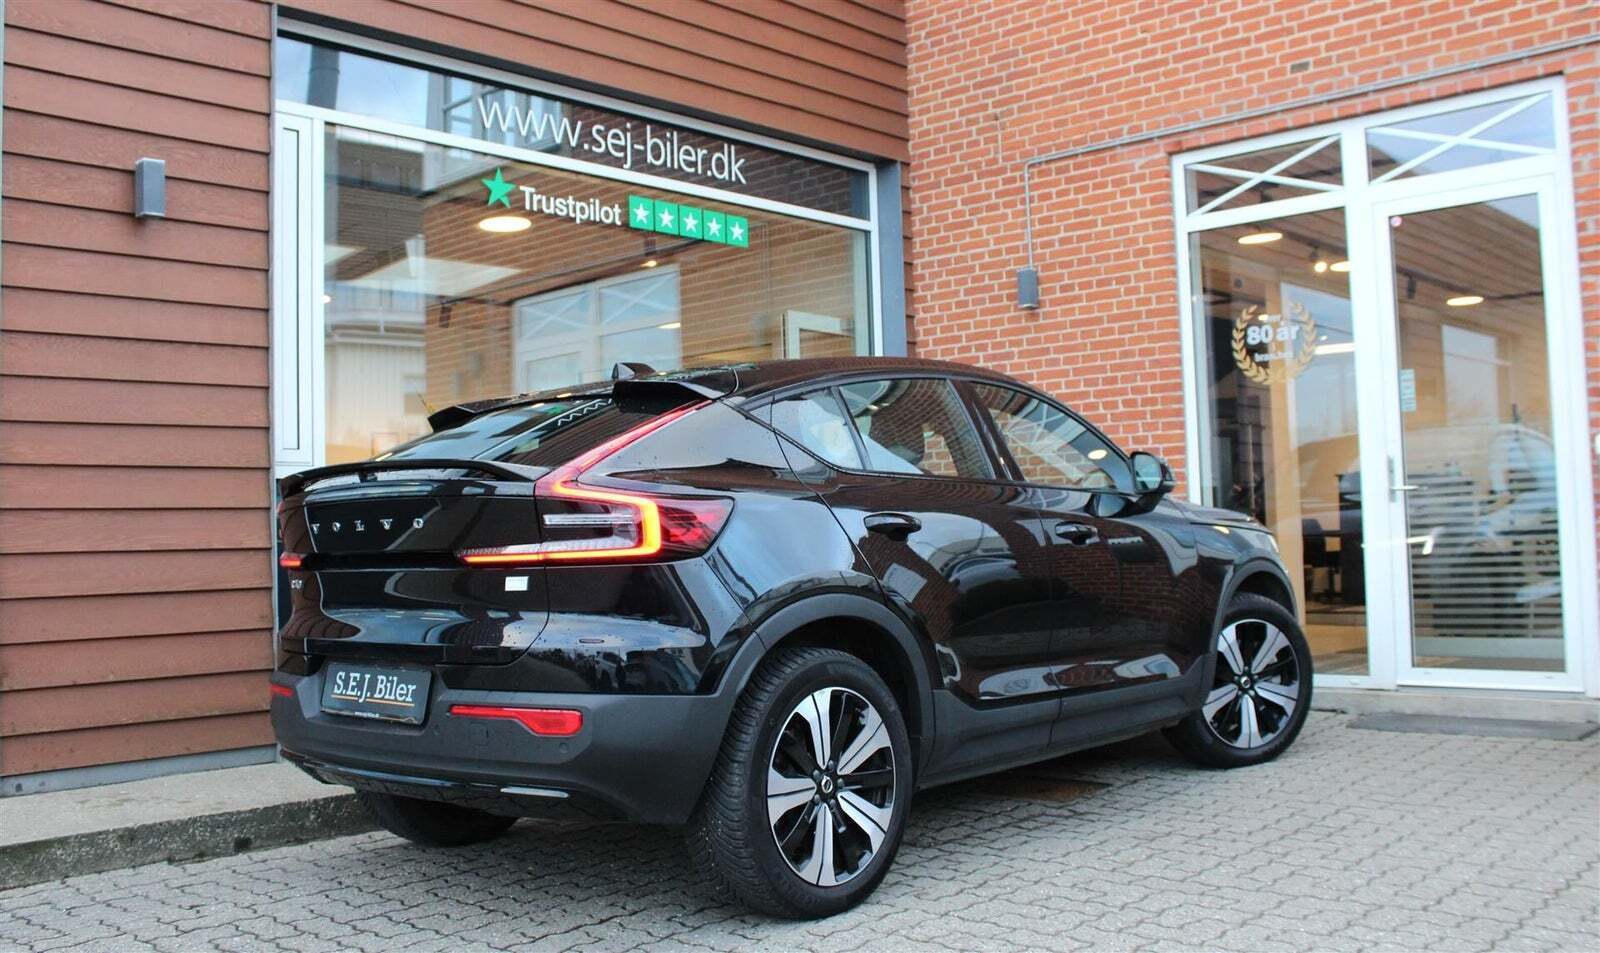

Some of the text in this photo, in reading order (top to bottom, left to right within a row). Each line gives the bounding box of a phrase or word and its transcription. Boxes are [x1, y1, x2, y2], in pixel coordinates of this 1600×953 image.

[478, 98, 746, 184] www.sej-biler.dk
[519, 185, 622, 225] Trustpilot
[1245, 325, 1273, 345] 80
[310, 518, 424, 534] VOLVO
[333, 671, 417, 702] S.E.J. Biler
